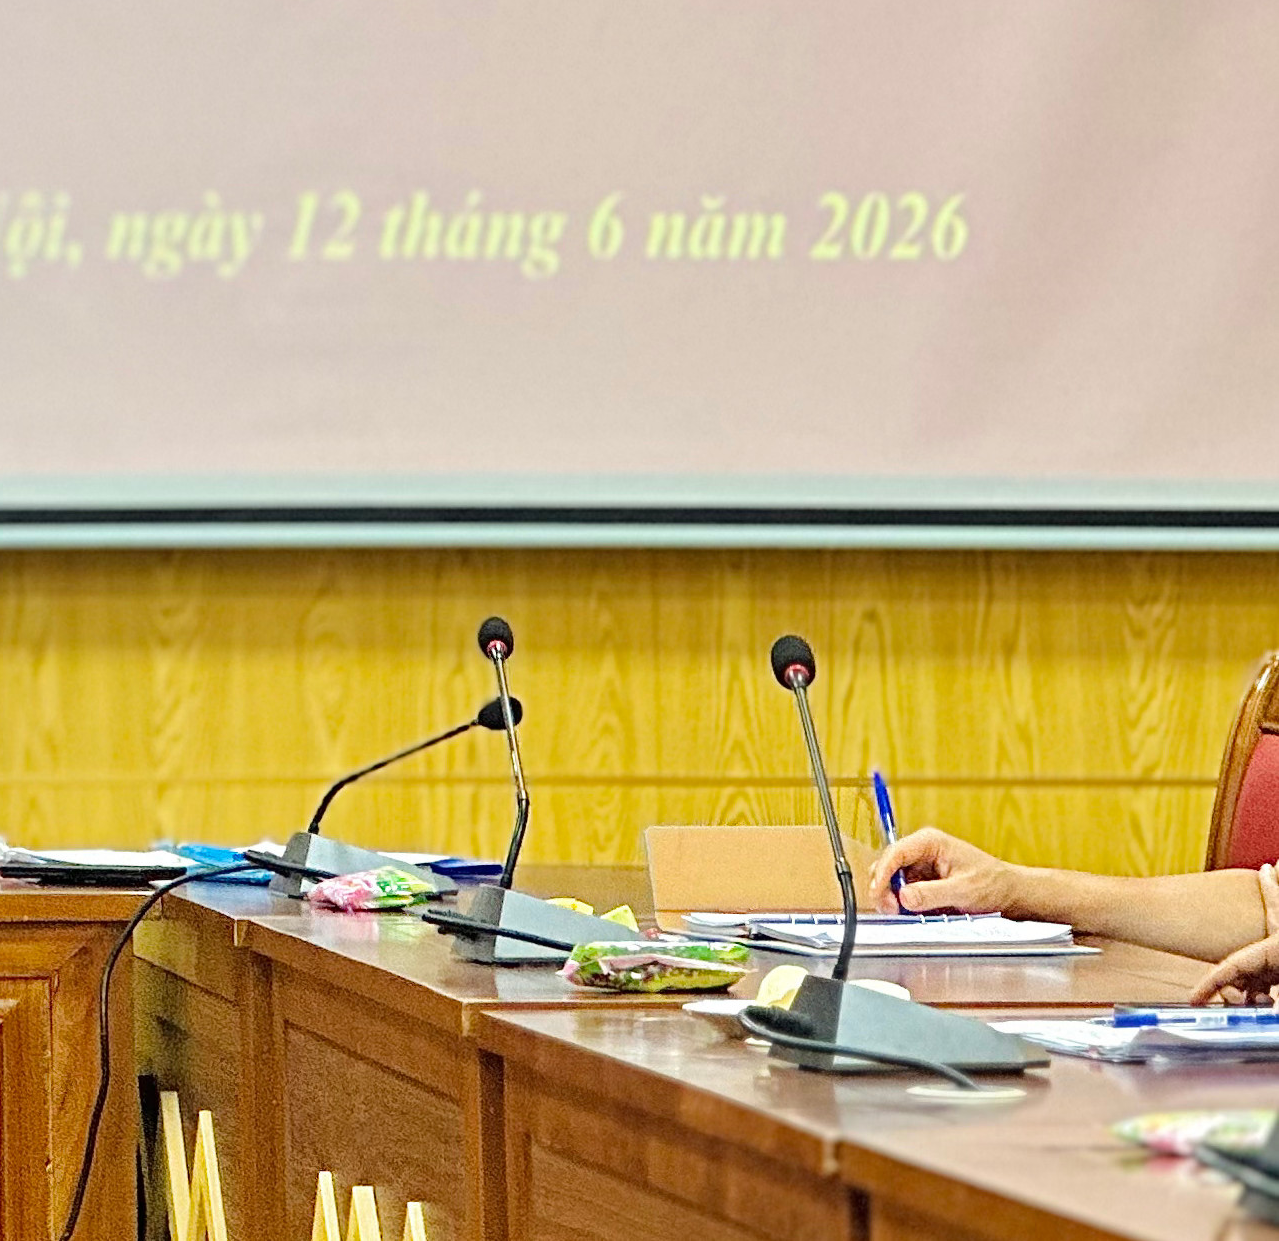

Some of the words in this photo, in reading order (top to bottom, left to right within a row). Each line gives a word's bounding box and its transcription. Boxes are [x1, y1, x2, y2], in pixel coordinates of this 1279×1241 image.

[105, 191, 263, 279] ngày
[287, 187, 363, 262] 12
[377, 189, 568, 276] tháng
[585, 193, 624, 259] 6
[644, 195, 787, 260] năm
[809, 189, 970, 262] 2026
